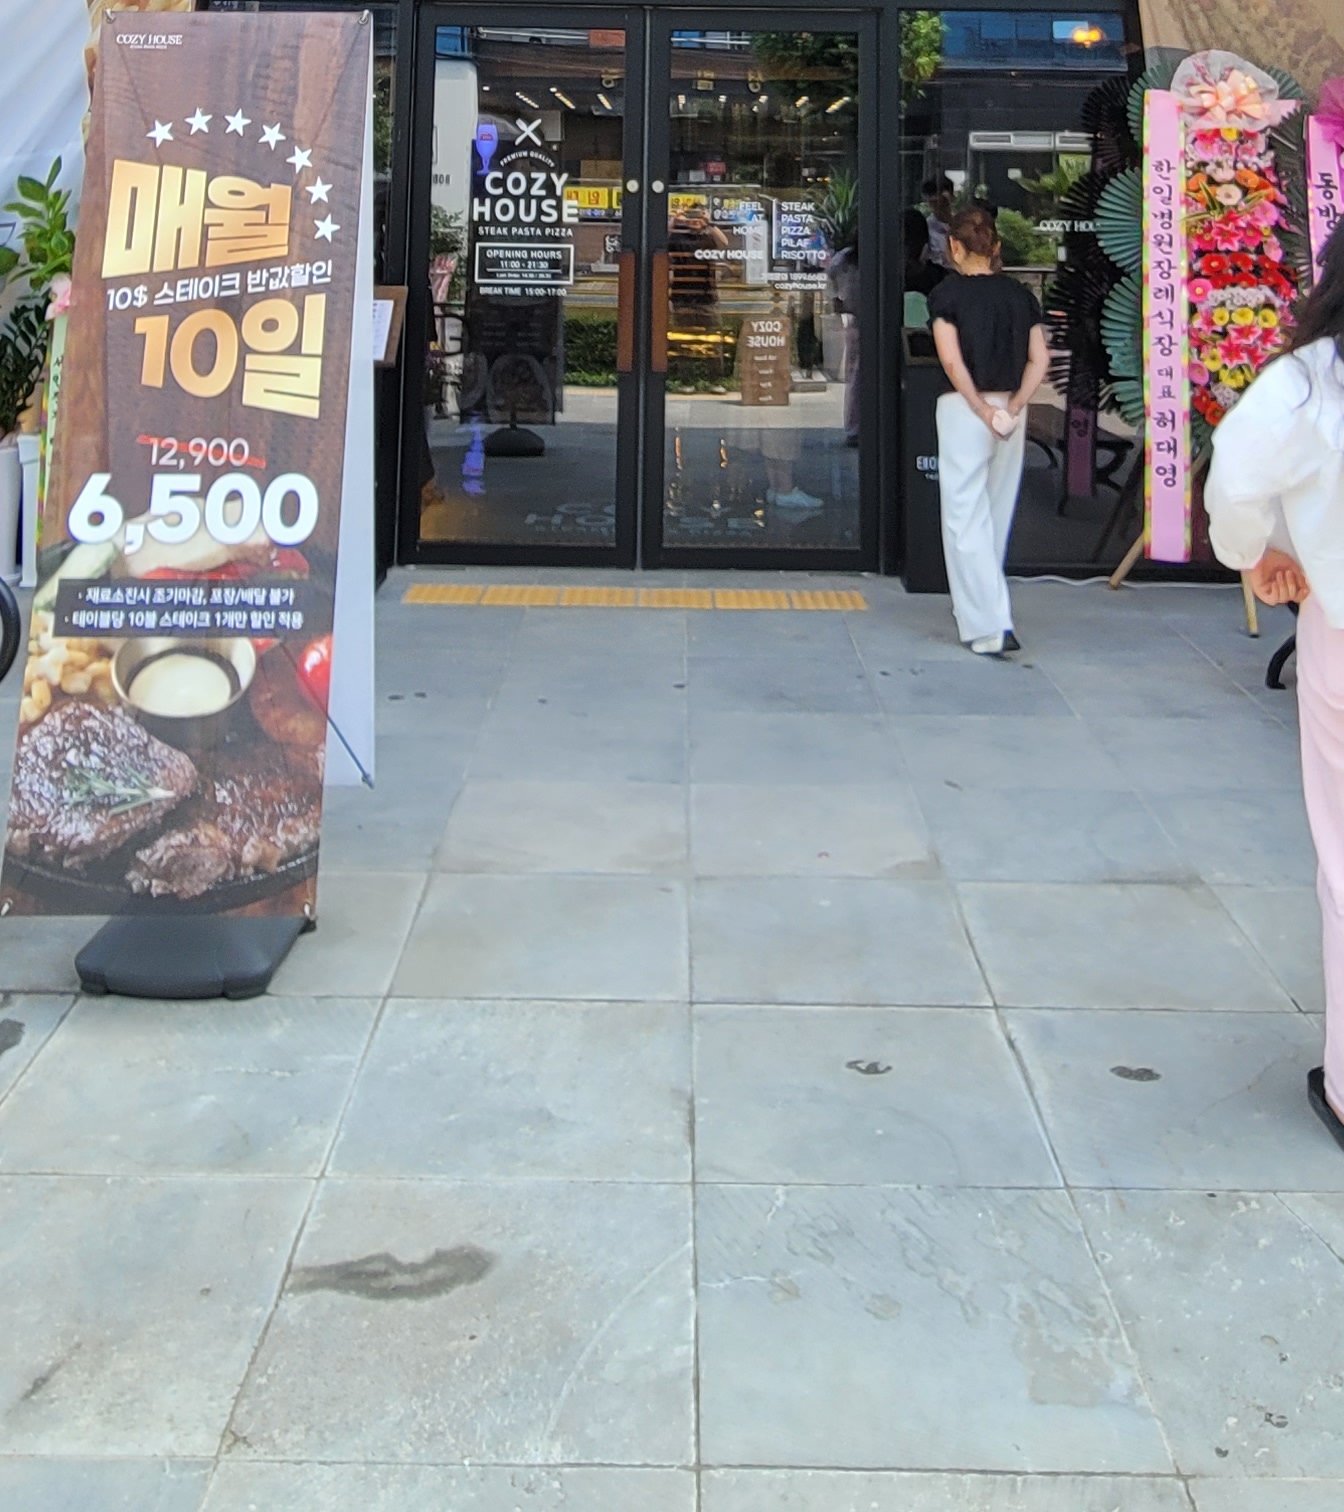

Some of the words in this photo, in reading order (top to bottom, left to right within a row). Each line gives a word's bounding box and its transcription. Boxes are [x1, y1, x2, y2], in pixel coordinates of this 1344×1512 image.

[116, 33, 146, 44] COZY
[148, 34, 183, 45] HOUSE
[500, 151, 528, 167] PREMIUM
[530, 151, 555, 168] QUALITY
[485, 171, 568, 196] COZY
[473, 197, 579, 223] HOUSE
[739, 201, 764, 211] FEEL
[781, 201, 815, 211] STEAK
[101, 159, 292, 278] 매월
[752, 214, 764, 223] AT
[781, 214, 814, 223] PASTA
[478, 225, 508, 236] STEAK
[511, 226, 542, 237] PASTA
[545, 227, 573, 237] PIZZA
[733, 226, 764, 235] HOME
[781, 226, 811, 236] PIZZA
[1040, 220, 1072, 232] COZY
[781, 238, 810, 247] PILAF
[486, 249, 528, 259] OPENING
[530, 250, 562, 260] HOURS
[694, 249, 725, 260] COZY
[727, 250, 764, 260] HOUSE
[781, 250, 827, 260] RISOTTO
[1150, 159, 1178, 357] 한일병원장례식장
[107, 284, 148, 311] 10$
[153, 272, 241, 306] 스테이크
[246, 259, 333, 294] 반값할인
[134, 292, 327, 419] 10일
[1156, 367, 1175, 399] 대표
[149, 437, 250, 470] 12,900
[67, 472, 319, 555] 6,500
[86, 586, 151, 605] 재료소진시
[159, 610, 211, 628] 스테이크
